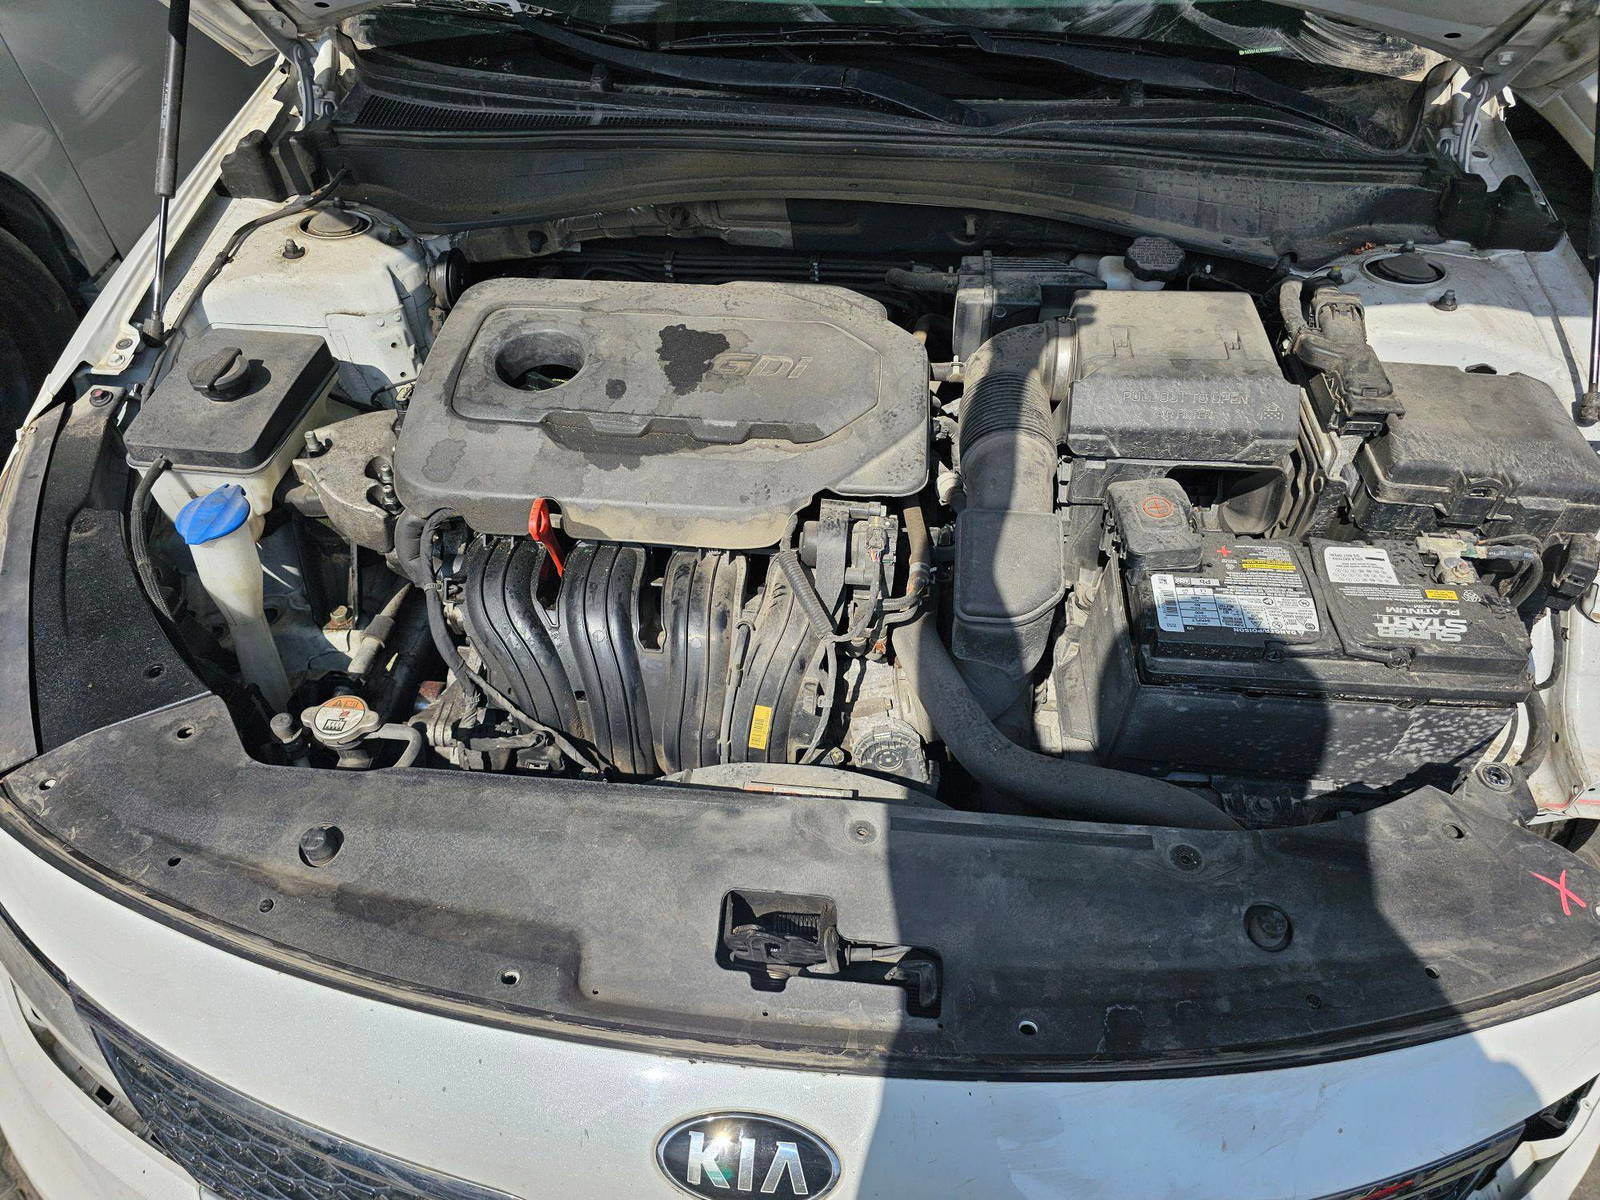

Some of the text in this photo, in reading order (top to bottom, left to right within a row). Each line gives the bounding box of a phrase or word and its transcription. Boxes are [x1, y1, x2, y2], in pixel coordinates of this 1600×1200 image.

[1385, 606, 1460, 616] PLATINUM
[1373, 613, 1468, 633] START
[1378, 625, 1462, 642] SUPER
[687, 1130, 809, 1196] KIA
